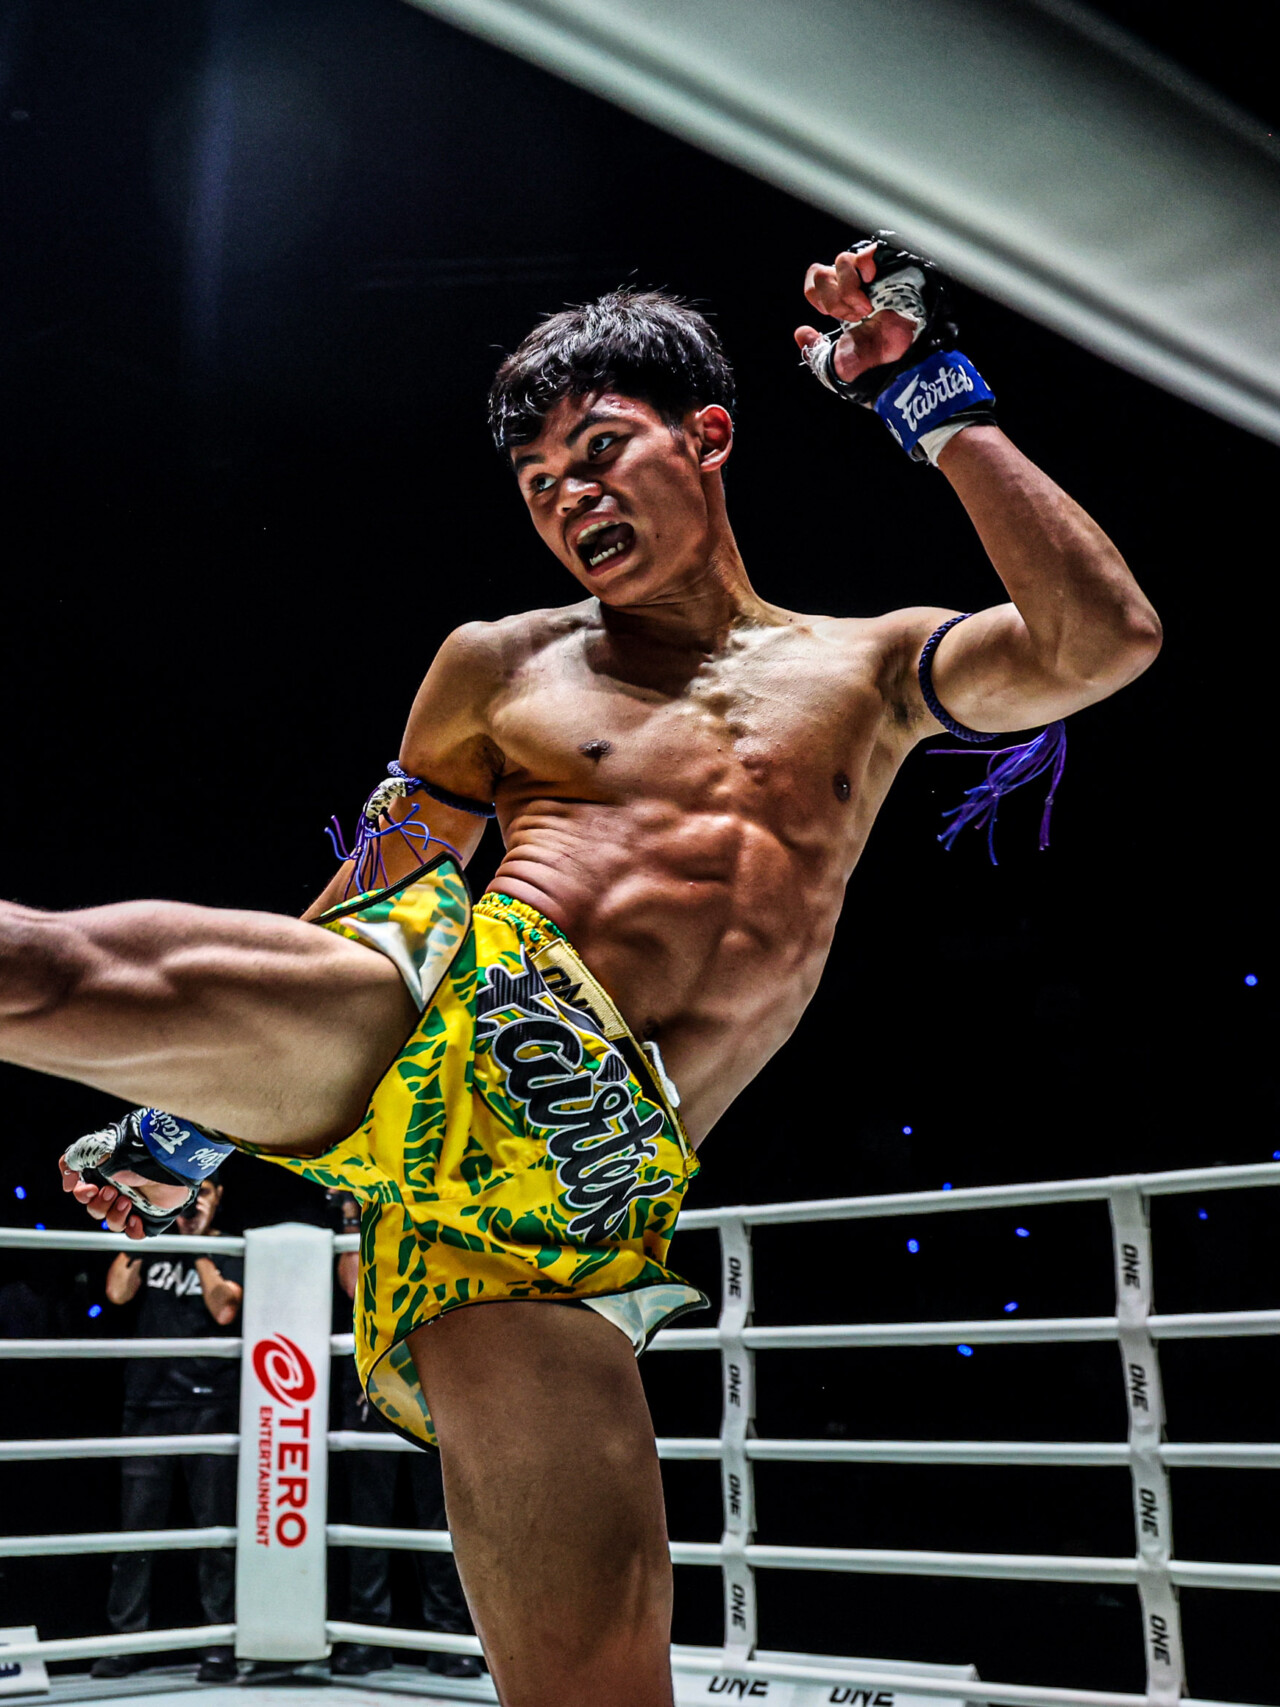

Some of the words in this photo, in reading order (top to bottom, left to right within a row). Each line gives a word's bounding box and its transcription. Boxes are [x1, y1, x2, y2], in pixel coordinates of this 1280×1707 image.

[894, 364, 974, 432] Fairtex
[727, 1257, 743, 1300] ONE
[1121, 1243, 1141, 1291] ONE
[727, 1364, 742, 1409] ONE
[1129, 1363, 1149, 1412] ONE
[256, 1405, 273, 1548] ENTERTAINMENT
[275, 1407, 310, 1548] TERO
[728, 1473, 742, 1519] ONE
[1140, 1488, 1159, 1538] ONE
[730, 1583, 746, 1632] ONE
[1150, 1613, 1171, 1667] ONE
